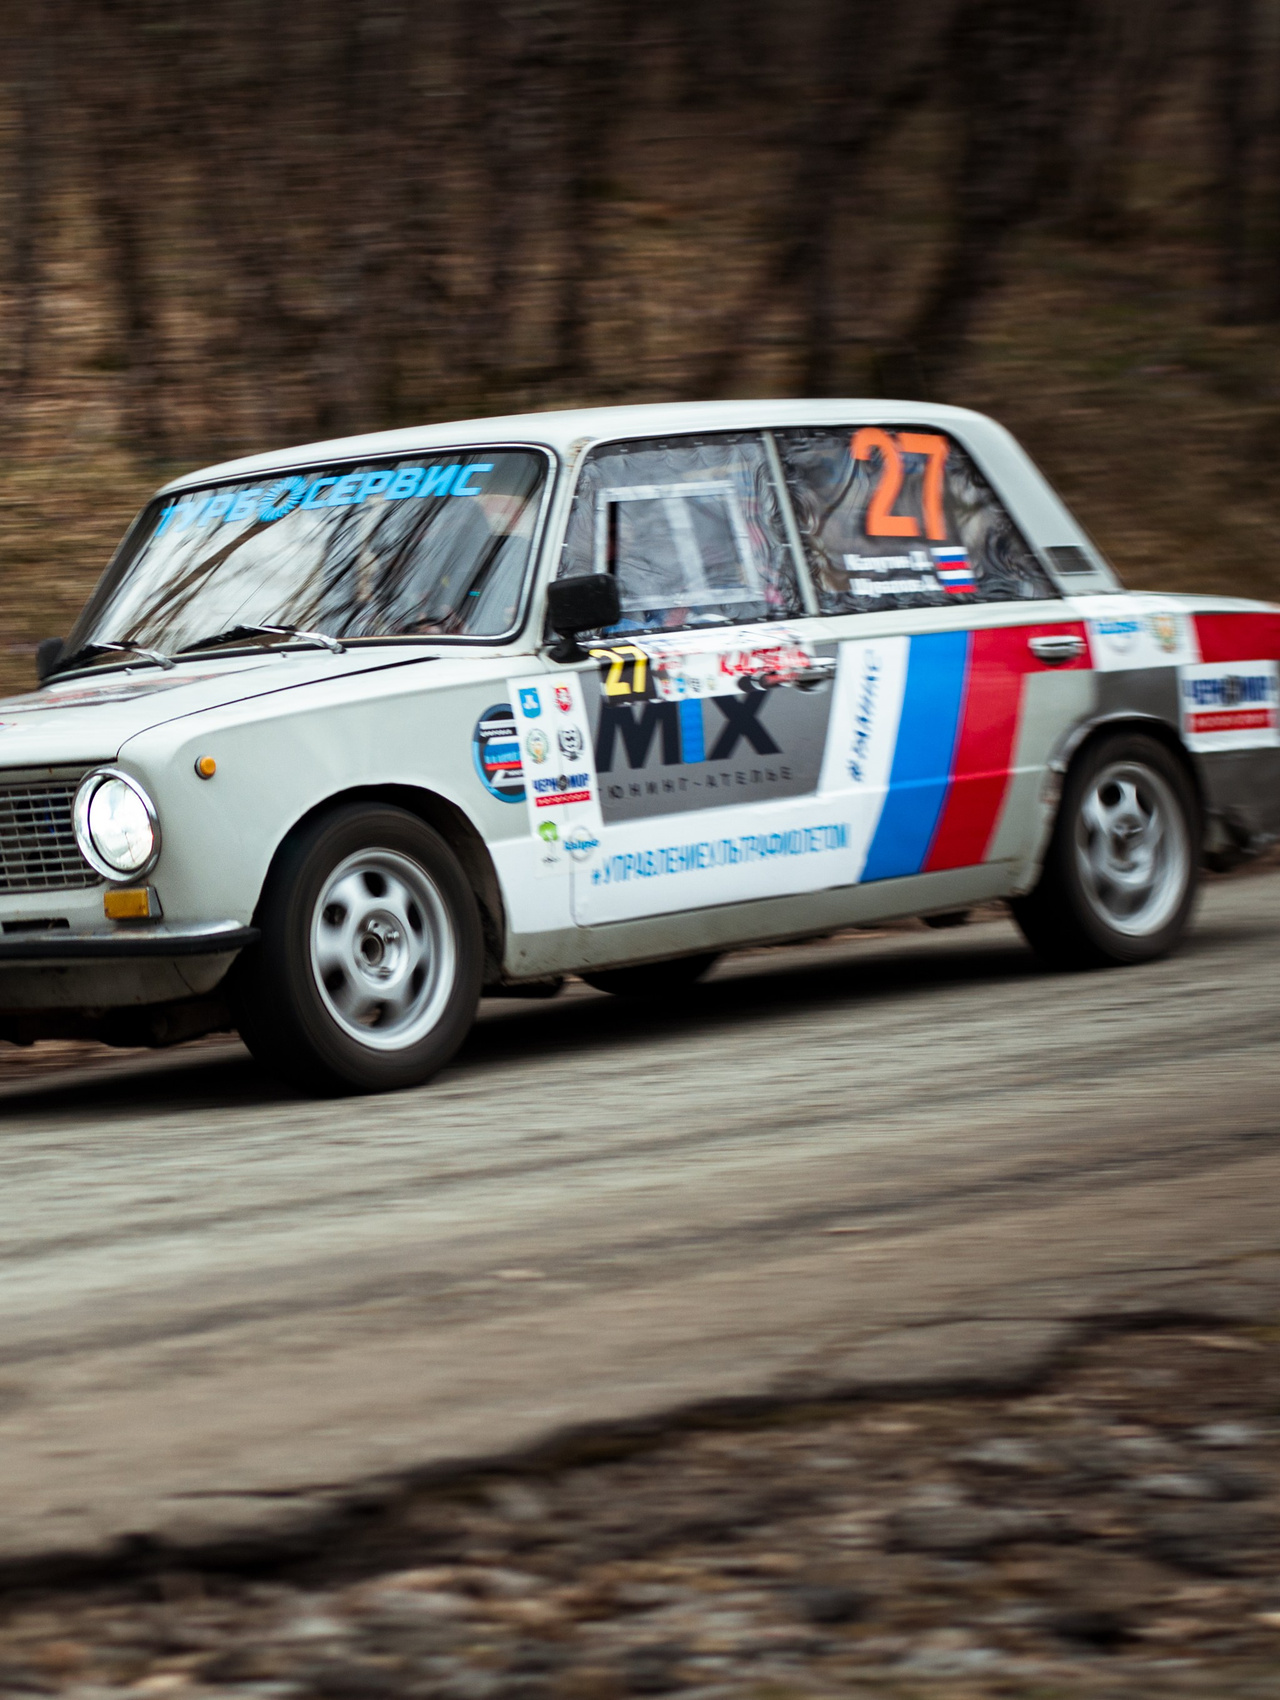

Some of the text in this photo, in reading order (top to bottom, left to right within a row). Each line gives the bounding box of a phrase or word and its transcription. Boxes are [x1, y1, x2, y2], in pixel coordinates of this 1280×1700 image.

[154, 463, 494, 537] ТУРБОСЕРВИС
[851, 427, 950, 540] 27
[589, 645, 648, 696] 27
[598, 766, 794, 799] ЮНИНГ-АТЕЛЬЕ
